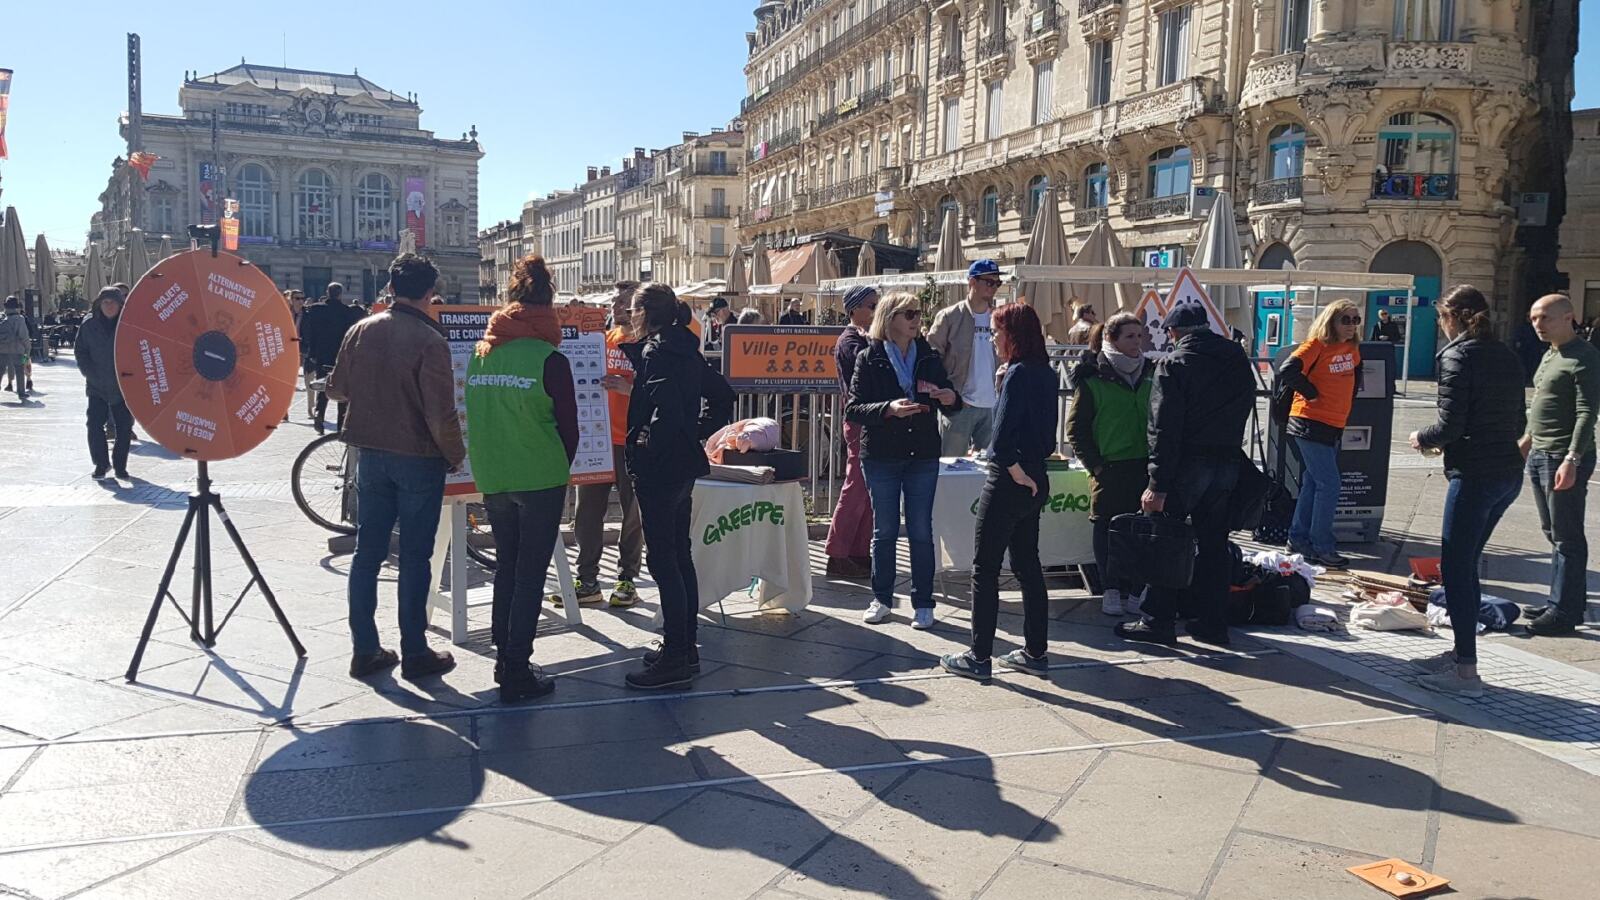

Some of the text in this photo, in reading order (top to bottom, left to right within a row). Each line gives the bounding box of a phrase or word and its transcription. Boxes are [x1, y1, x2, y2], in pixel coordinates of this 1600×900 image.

[208, 272, 256, 298] ALTERNATIVES
[152, 283, 182, 311] PROJETS
[159, 291, 189, 322] ROUTIERS
[214, 286, 224, 296] LA
[225, 288, 252, 309] VOITURE
[441, 314, 491, 324] TRANSPORT
[449, 329, 461, 339] DE
[140, 339, 154, 373] FAIBLES
[742, 341, 779, 356] Ville
[607, 358, 634, 371] SPIR
[468, 374, 537, 389] GREENPEACE
[149, 382, 161, 406] ZONE
[235, 384, 267, 419] LA VOITURE
[243, 394, 270, 424] PLACE DE
[176, 410, 216, 431] TRANSITION
[176, 422, 186, 432] LA
[193, 427, 215, 442] AIDES
